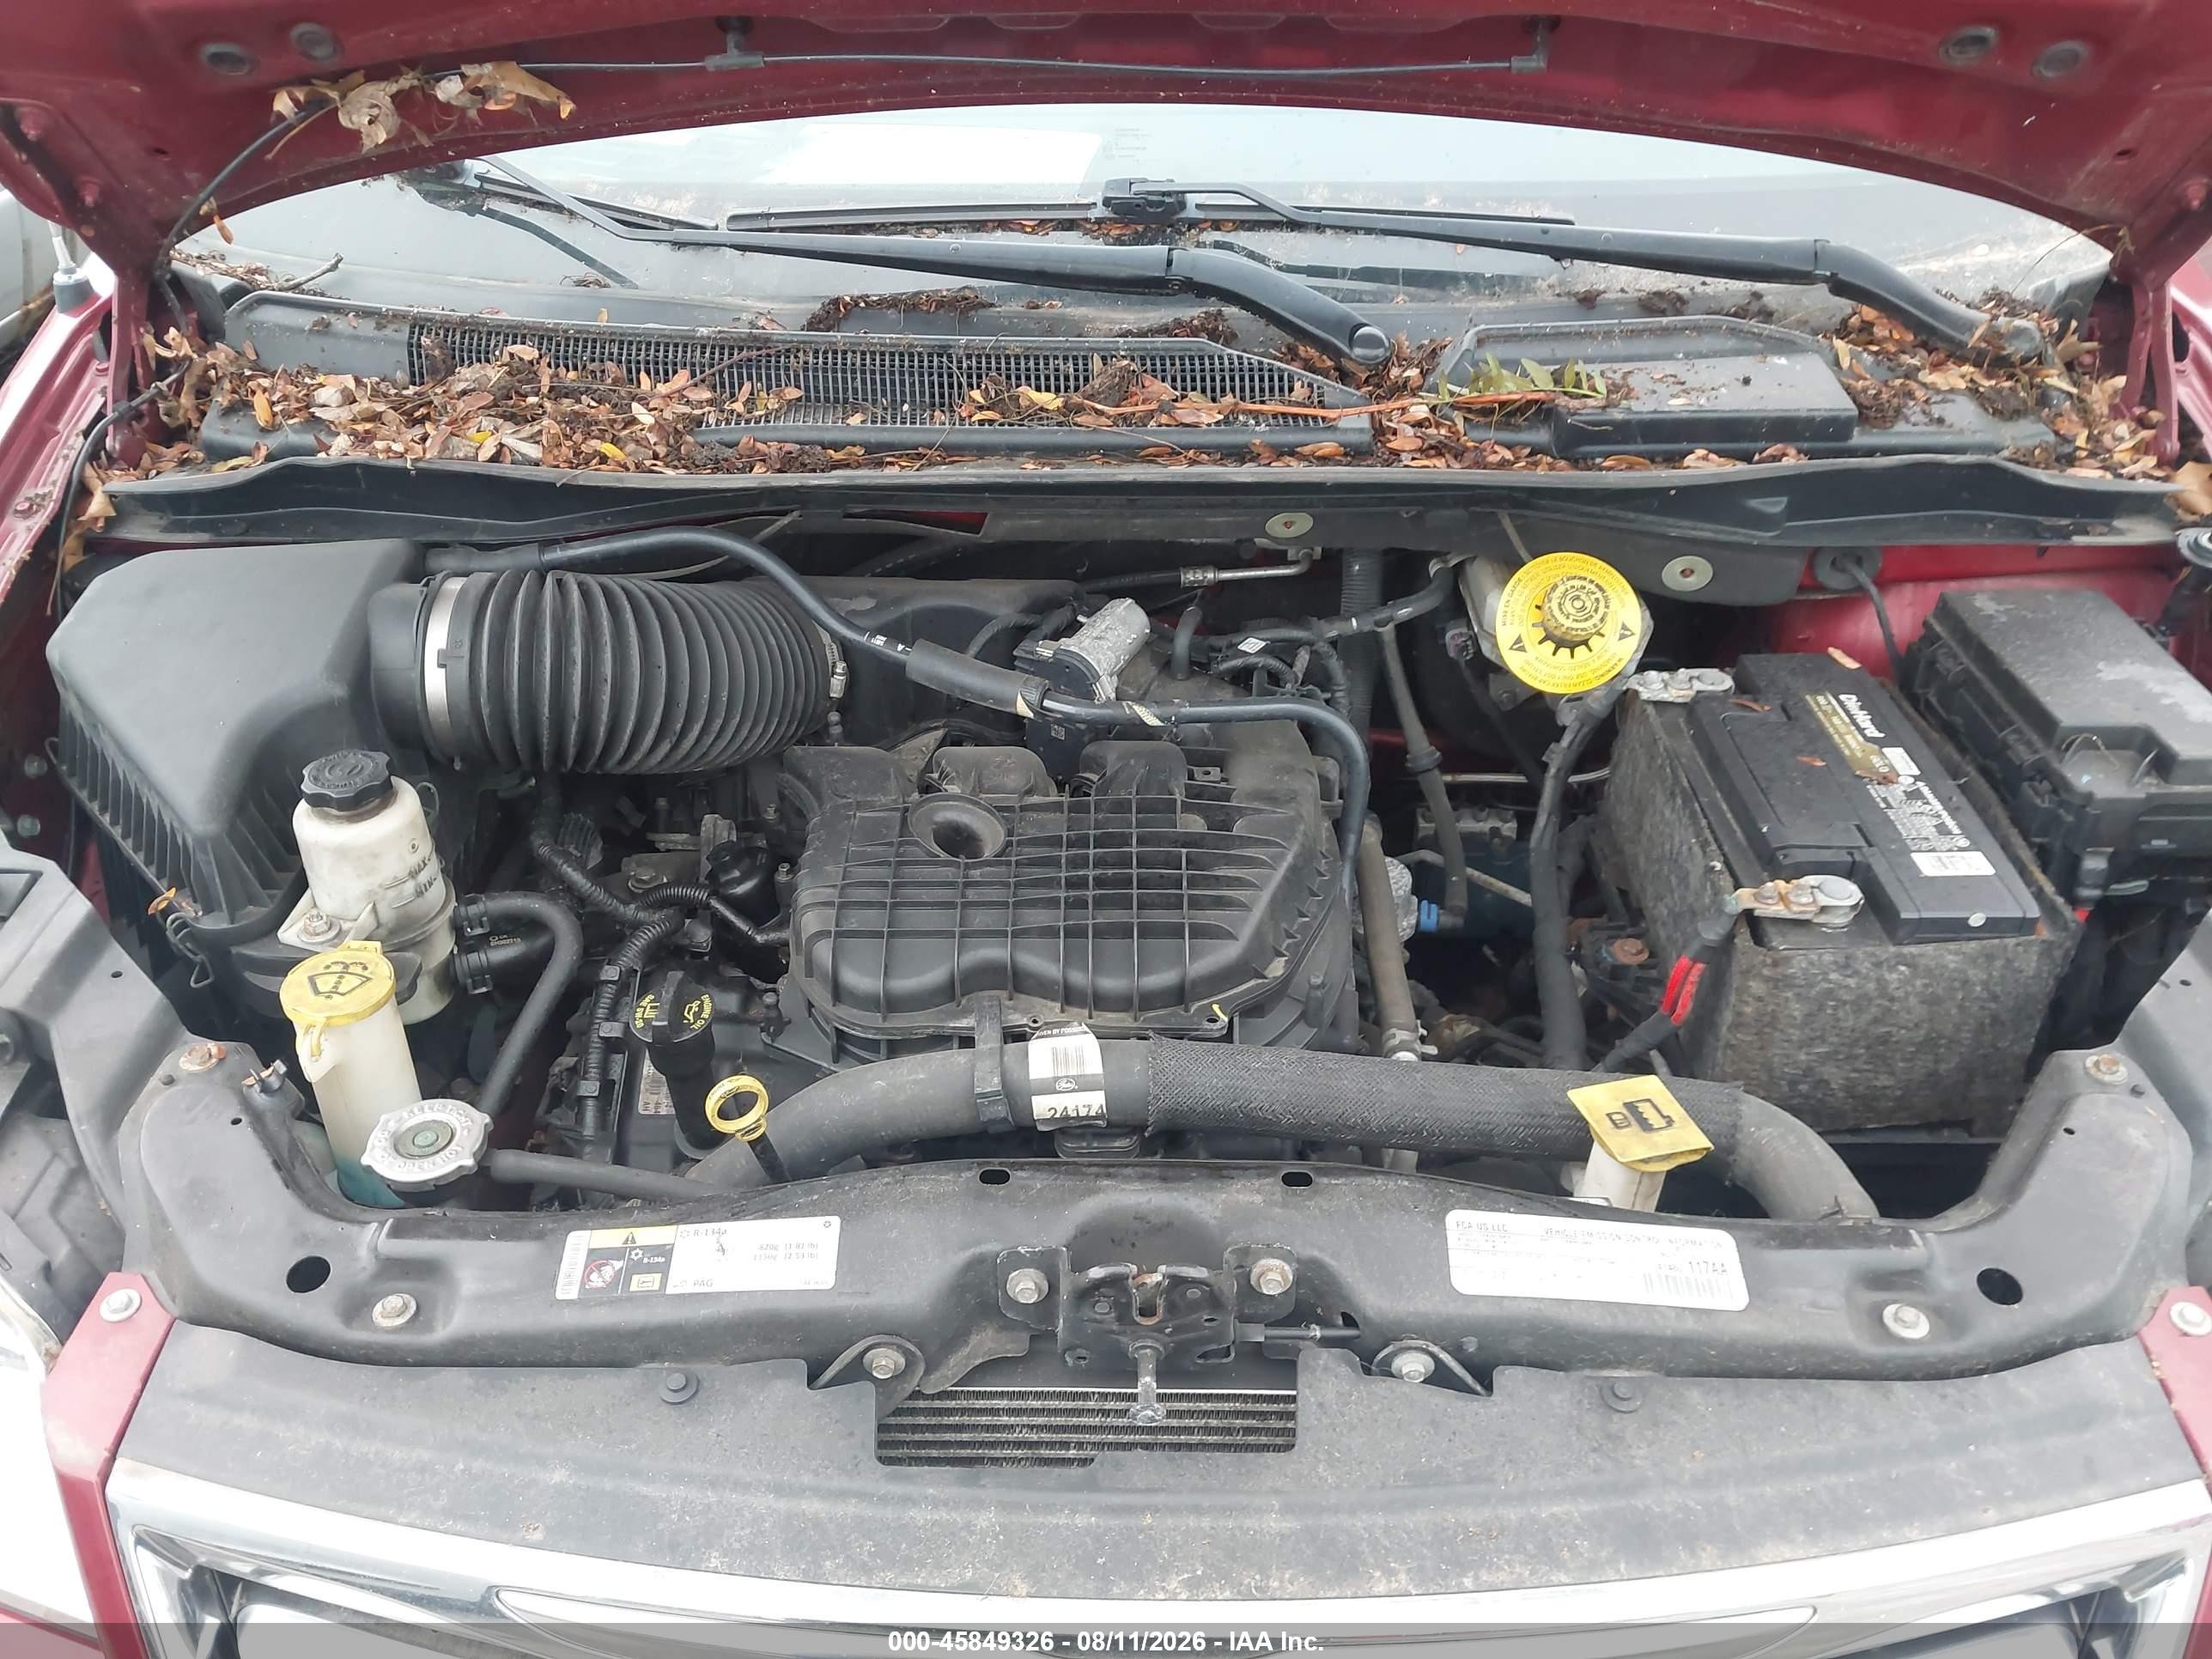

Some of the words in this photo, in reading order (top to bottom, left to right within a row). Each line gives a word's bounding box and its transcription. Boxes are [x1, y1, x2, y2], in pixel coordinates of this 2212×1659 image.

[1838, 694, 1886, 738] DieHard
[700, 994, 712, 1019] ENGINE
[634, 1007, 644, 1028] 5W-20
[690, 1018, 705, 1030] OIL
[1476, 1222, 1490, 1231] US
[692, 1278, 714, 1288] PAG
